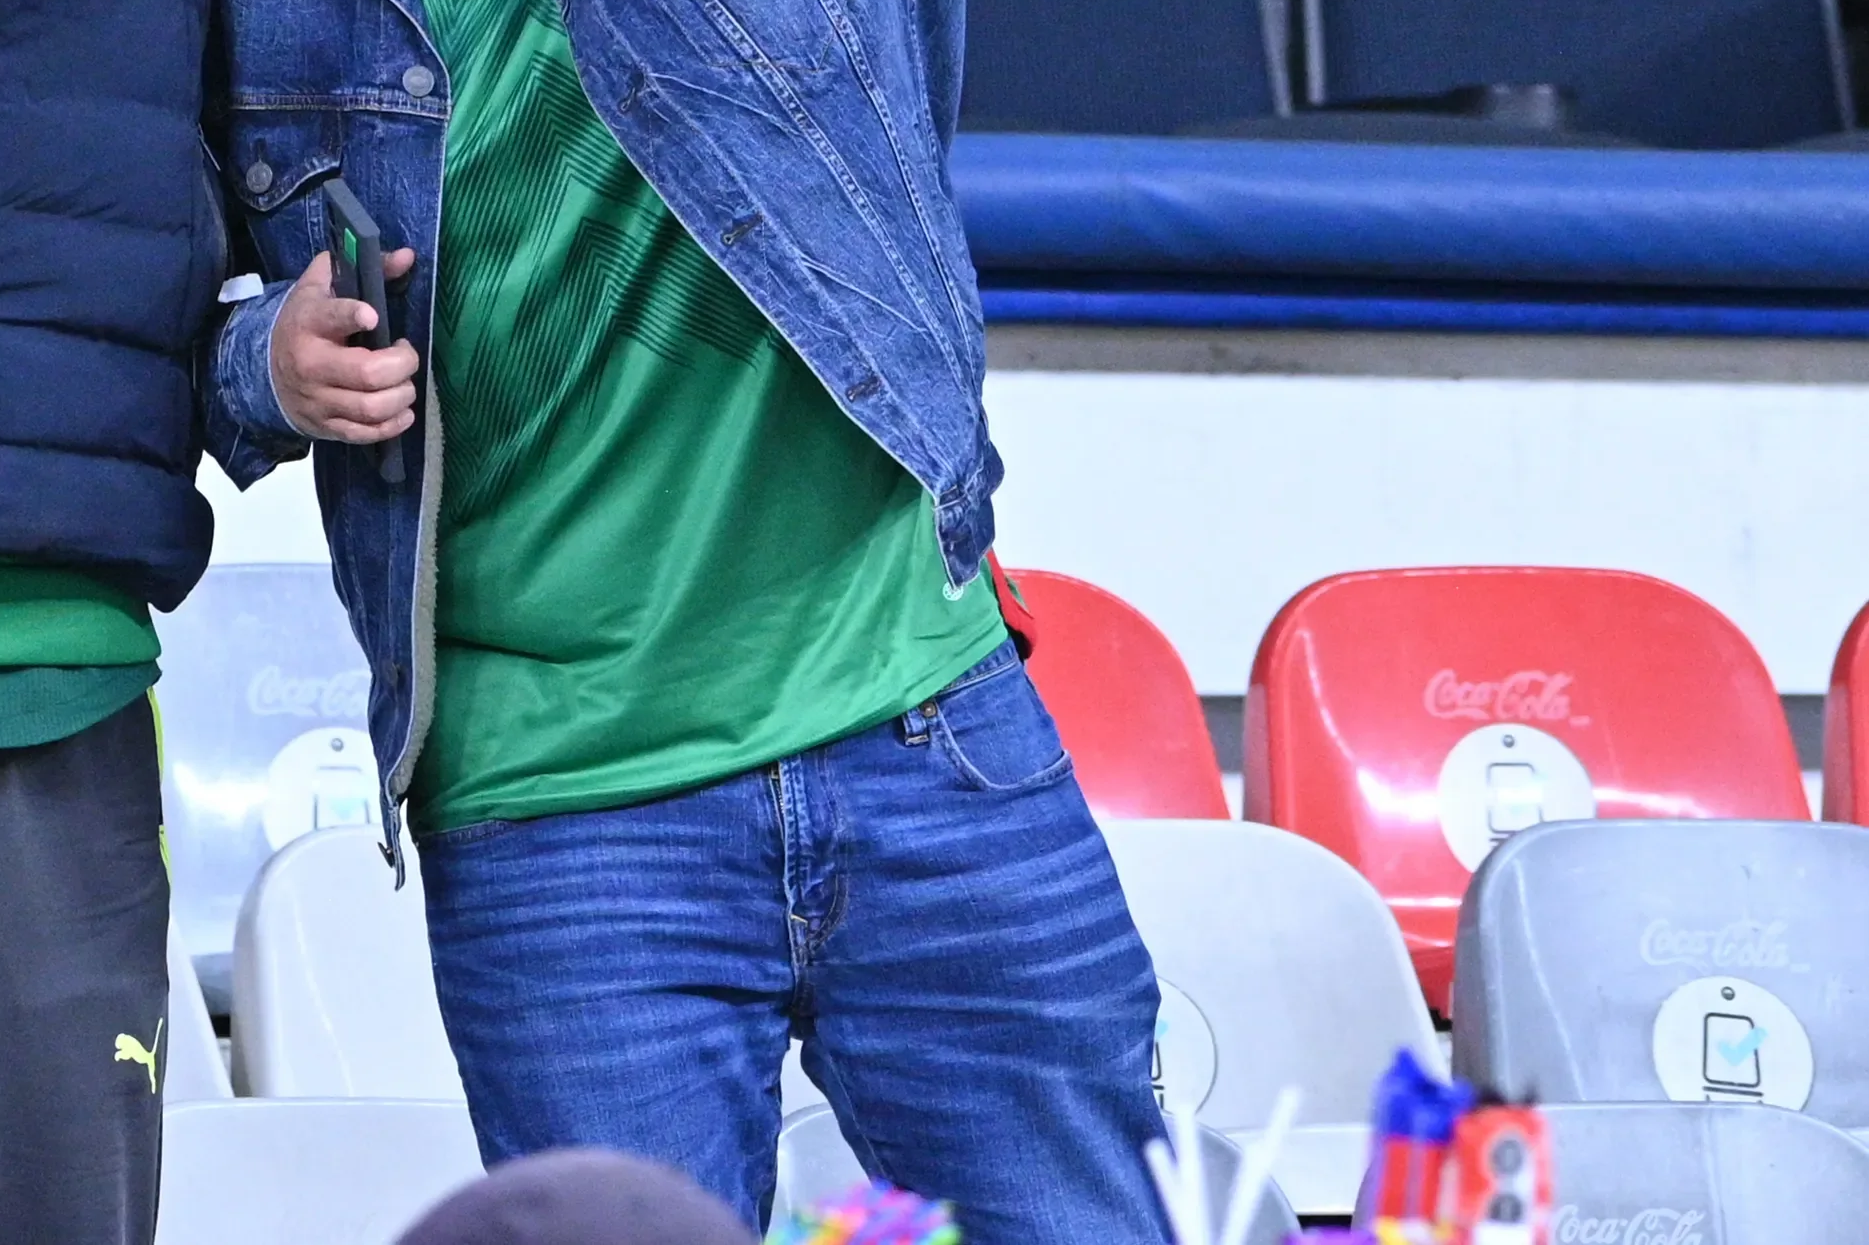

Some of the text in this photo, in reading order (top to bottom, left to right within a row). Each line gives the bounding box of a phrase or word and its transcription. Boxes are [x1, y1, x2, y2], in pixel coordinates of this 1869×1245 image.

[248, 665, 371, 717] Coca-Co
[1423, 668, 1573, 720] Coca-Cola
[1639, 917, 1790, 969] Coca-Cola
